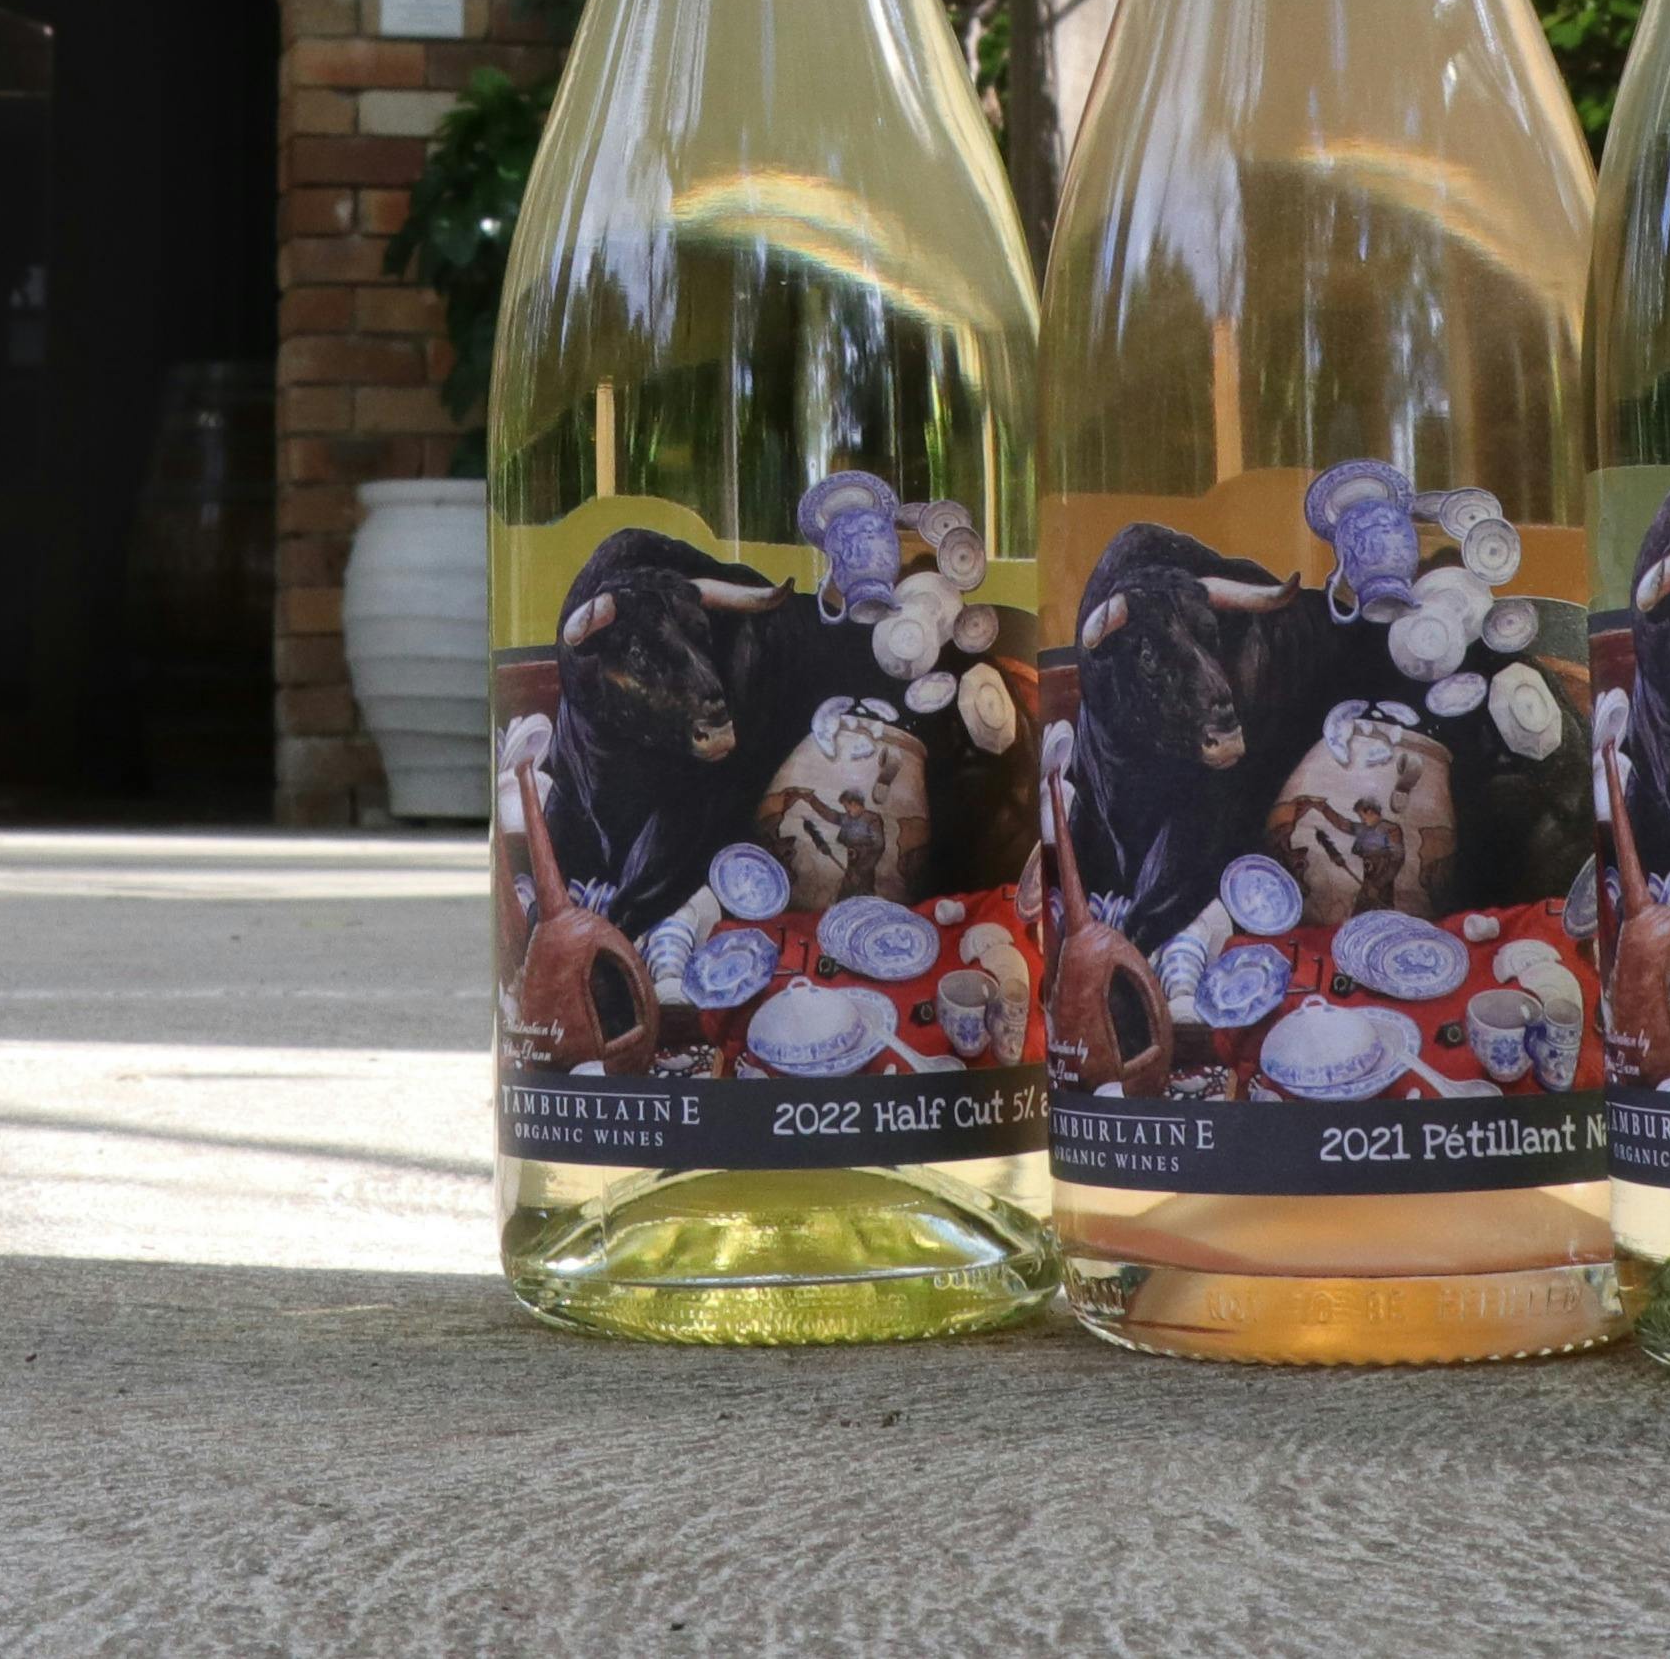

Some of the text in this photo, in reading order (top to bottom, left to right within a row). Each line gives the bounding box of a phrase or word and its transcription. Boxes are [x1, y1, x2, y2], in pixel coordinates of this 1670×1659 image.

[502, 1084, 701, 1125] TAMBURLAINE
[773, 1101, 861, 1135] 2022
[872, 1095, 946, 1133] Half
[953, 1089, 1004, 1128] Cut
[514, 1122, 664, 1147] ORGANIC WINES
[1051, 1113, 1215, 1150] AMBURLAINE
[1319, 1123, 1412, 1162] 2021
[1422, 1114, 1577, 1161] Pétillant
[1053, 1144, 1180, 1173] ORGANIC WINES
[1612, 1142, 1670, 1168] ORGANIC
